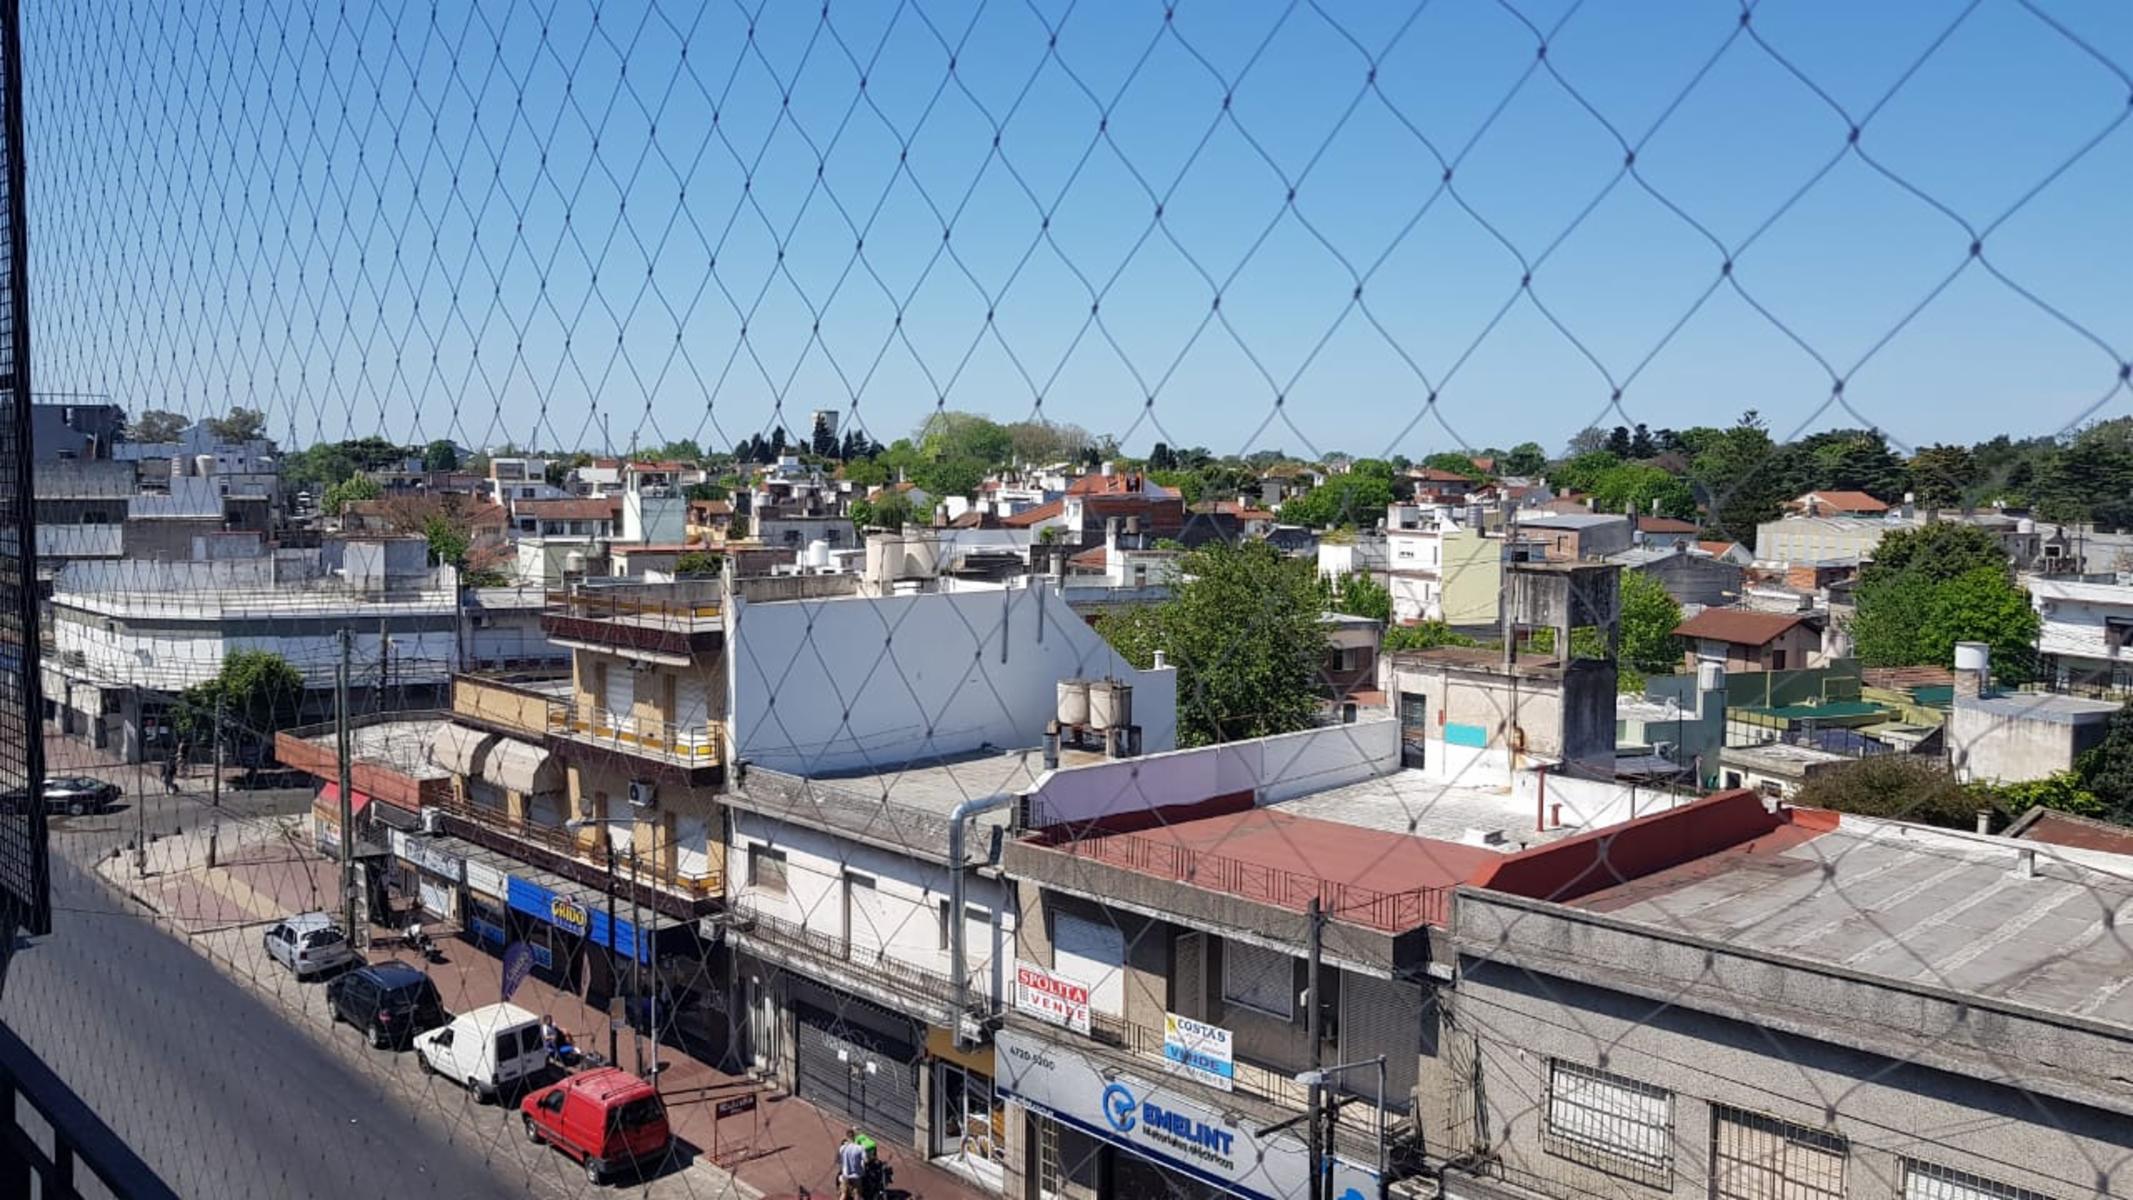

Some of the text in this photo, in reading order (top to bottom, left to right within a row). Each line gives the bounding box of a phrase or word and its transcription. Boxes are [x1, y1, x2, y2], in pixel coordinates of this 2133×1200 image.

[554, 902, 585, 925] GRIDO
[1030, 993, 1087, 1020] VENDE
[1178, 1019, 1226, 1042] COSTAS
[1143, 1102, 1234, 1156] EMELINT
